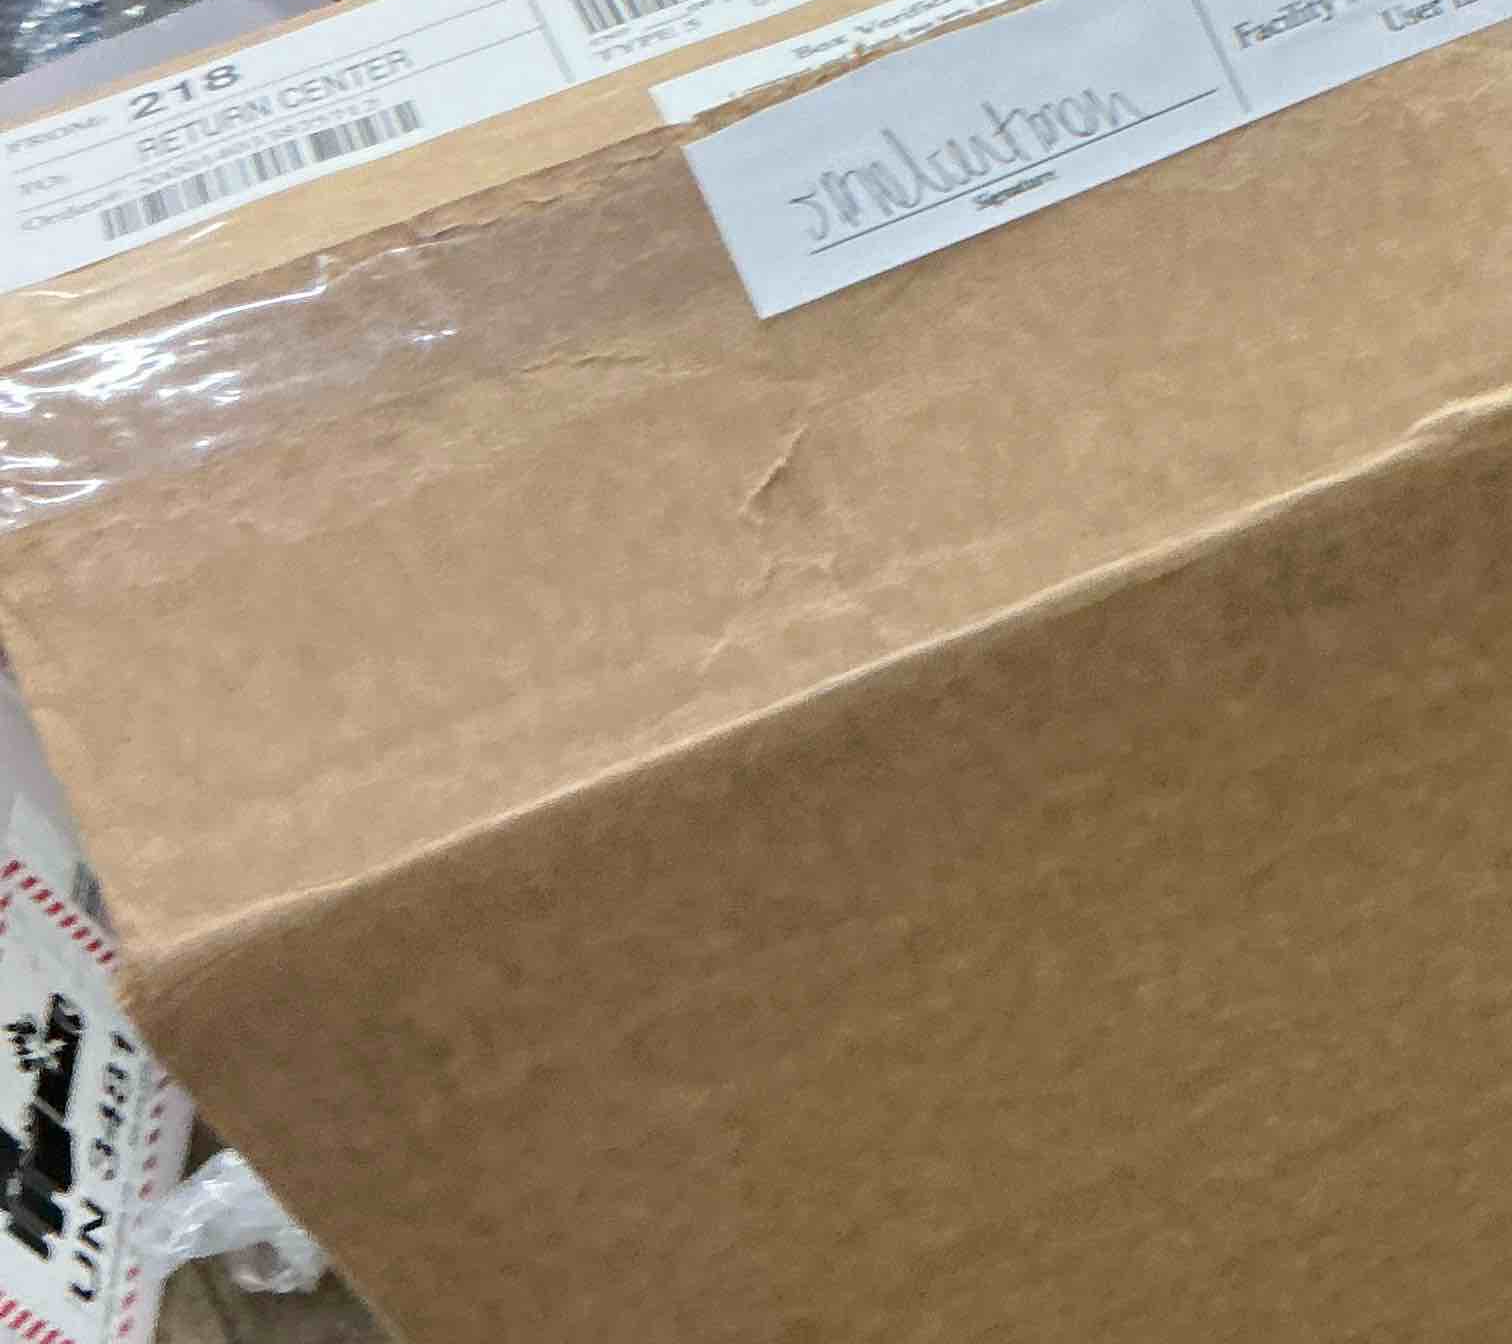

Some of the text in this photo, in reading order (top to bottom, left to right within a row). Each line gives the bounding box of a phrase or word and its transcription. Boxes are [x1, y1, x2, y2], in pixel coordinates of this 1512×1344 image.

[129, 63, 243, 121] 218
[136, 96, 274, 154] RETURN
[277, 48, 415, 110] CENTER
